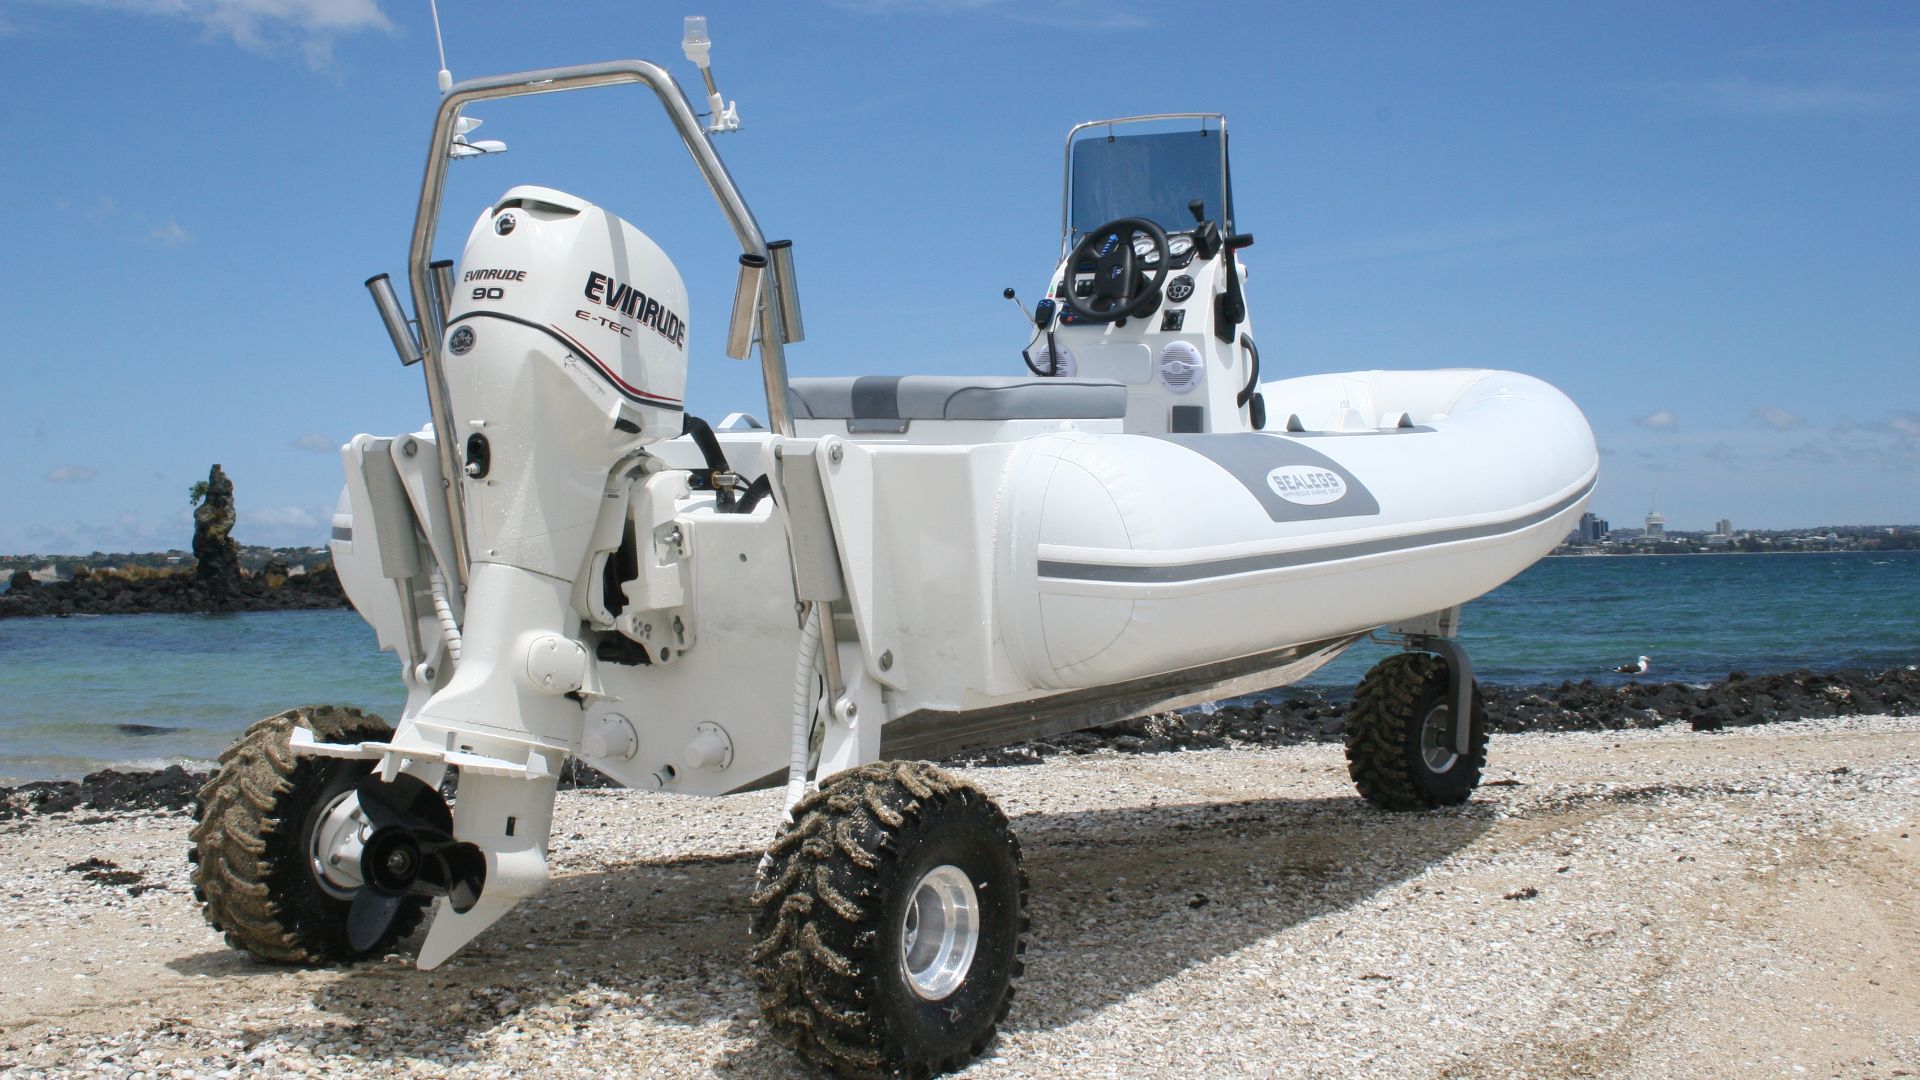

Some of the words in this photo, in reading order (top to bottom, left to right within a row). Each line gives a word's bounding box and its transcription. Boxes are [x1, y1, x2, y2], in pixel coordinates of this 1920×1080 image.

[464, 269, 527, 282] EVINRUDE
[472, 287, 504, 300] 90
[584, 270, 686, 352] EVINRUDE
[575, 309, 632, 338] E-TEC
[1272, 472, 1340, 491] SEALEGS
